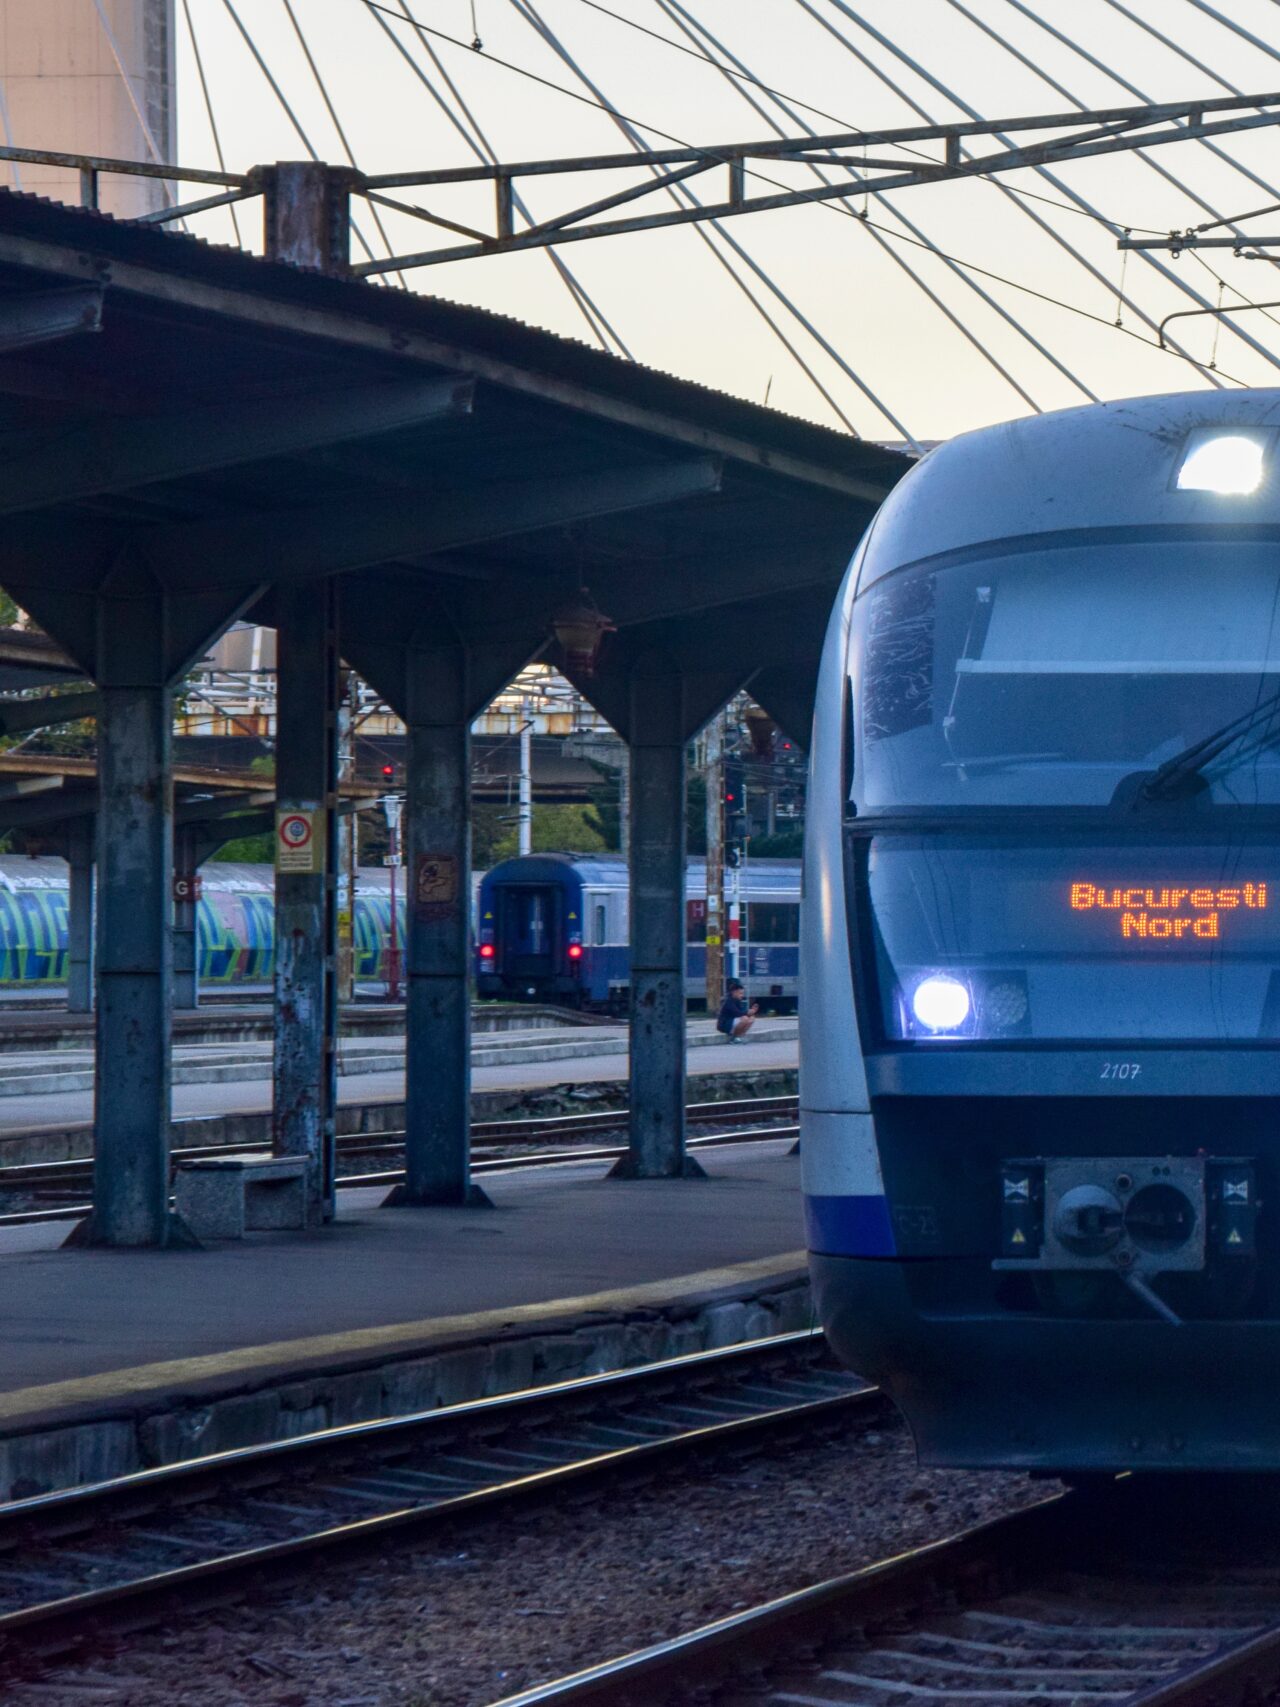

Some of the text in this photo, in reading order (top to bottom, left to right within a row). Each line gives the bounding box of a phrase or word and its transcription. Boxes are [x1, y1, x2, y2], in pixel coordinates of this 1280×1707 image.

[175, 880, 189, 895] G
[1071, 883, 1266, 908] Bucuresti
[692, 902, 704, 918] H
[1122, 912, 1218, 937] Nord
[1100, 1062, 1142, 1080] 2107
